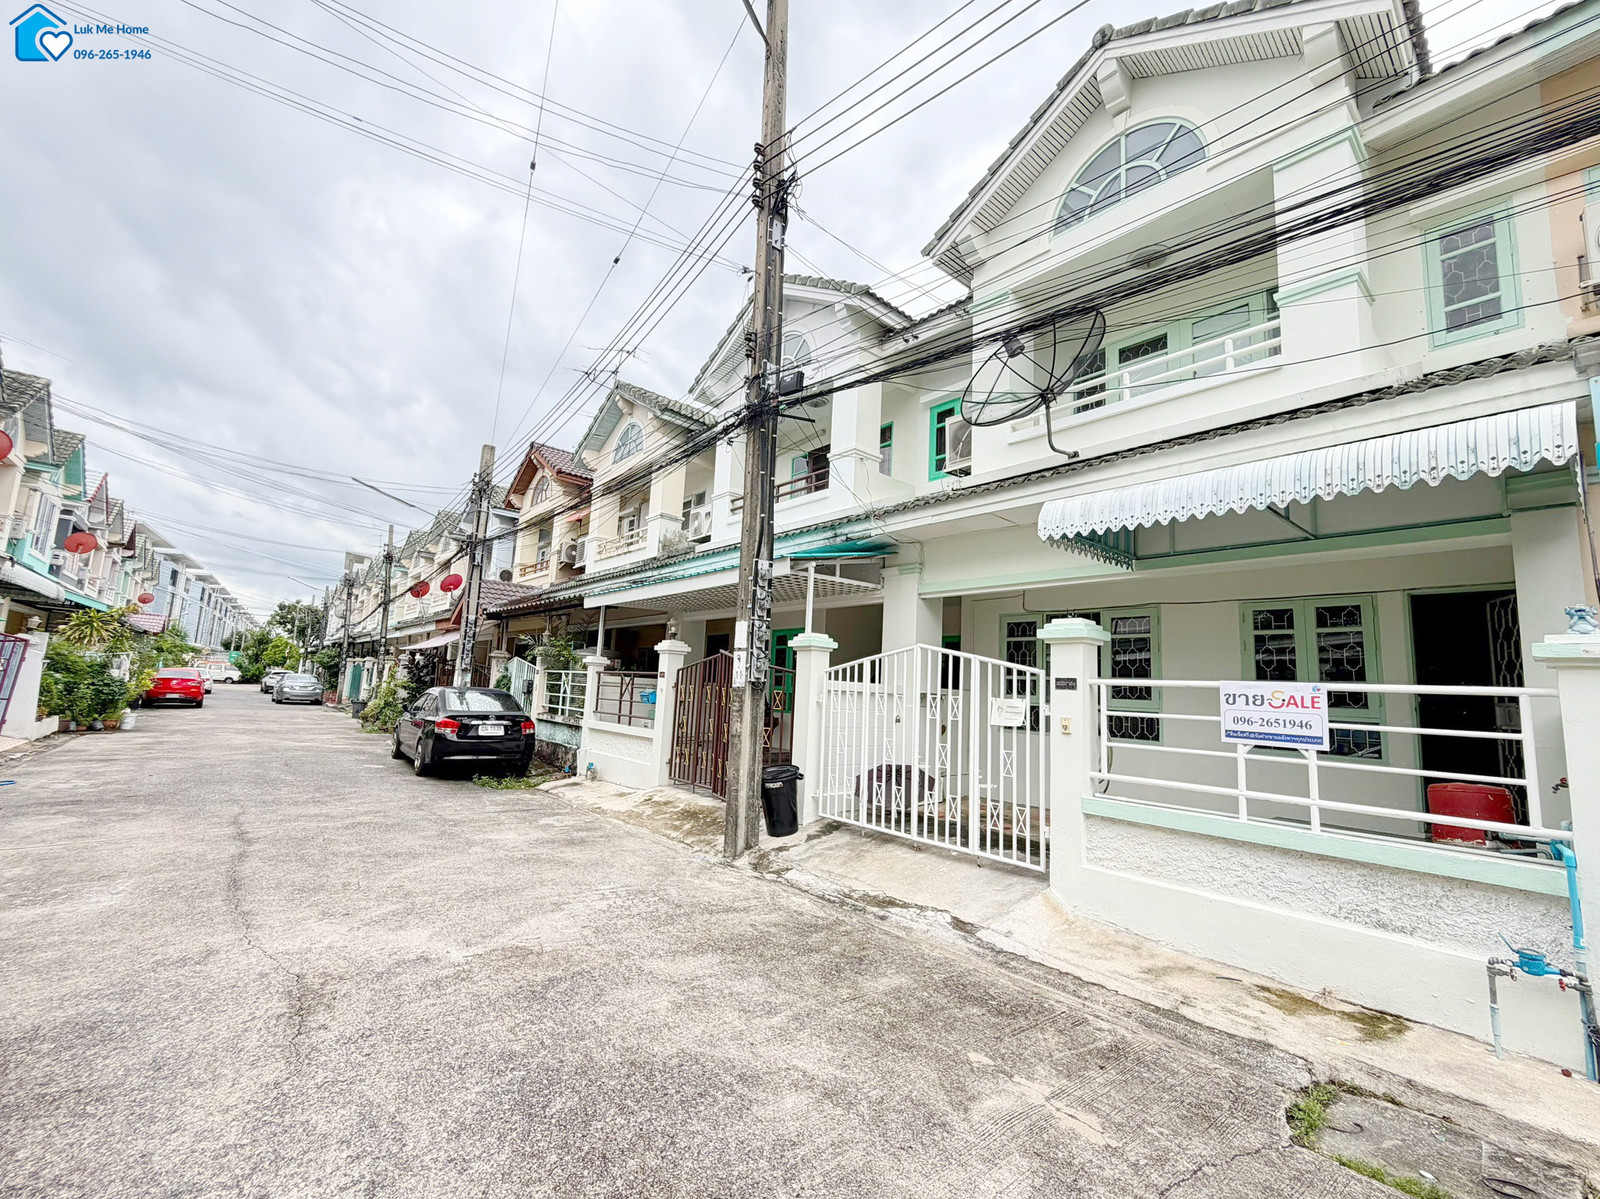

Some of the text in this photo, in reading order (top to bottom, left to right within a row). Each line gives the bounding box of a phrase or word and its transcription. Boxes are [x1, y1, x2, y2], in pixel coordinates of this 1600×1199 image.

[1224, 690, 1321, 710] ขาย SALE
[1232, 715, 1313, 731] 096-2651946
